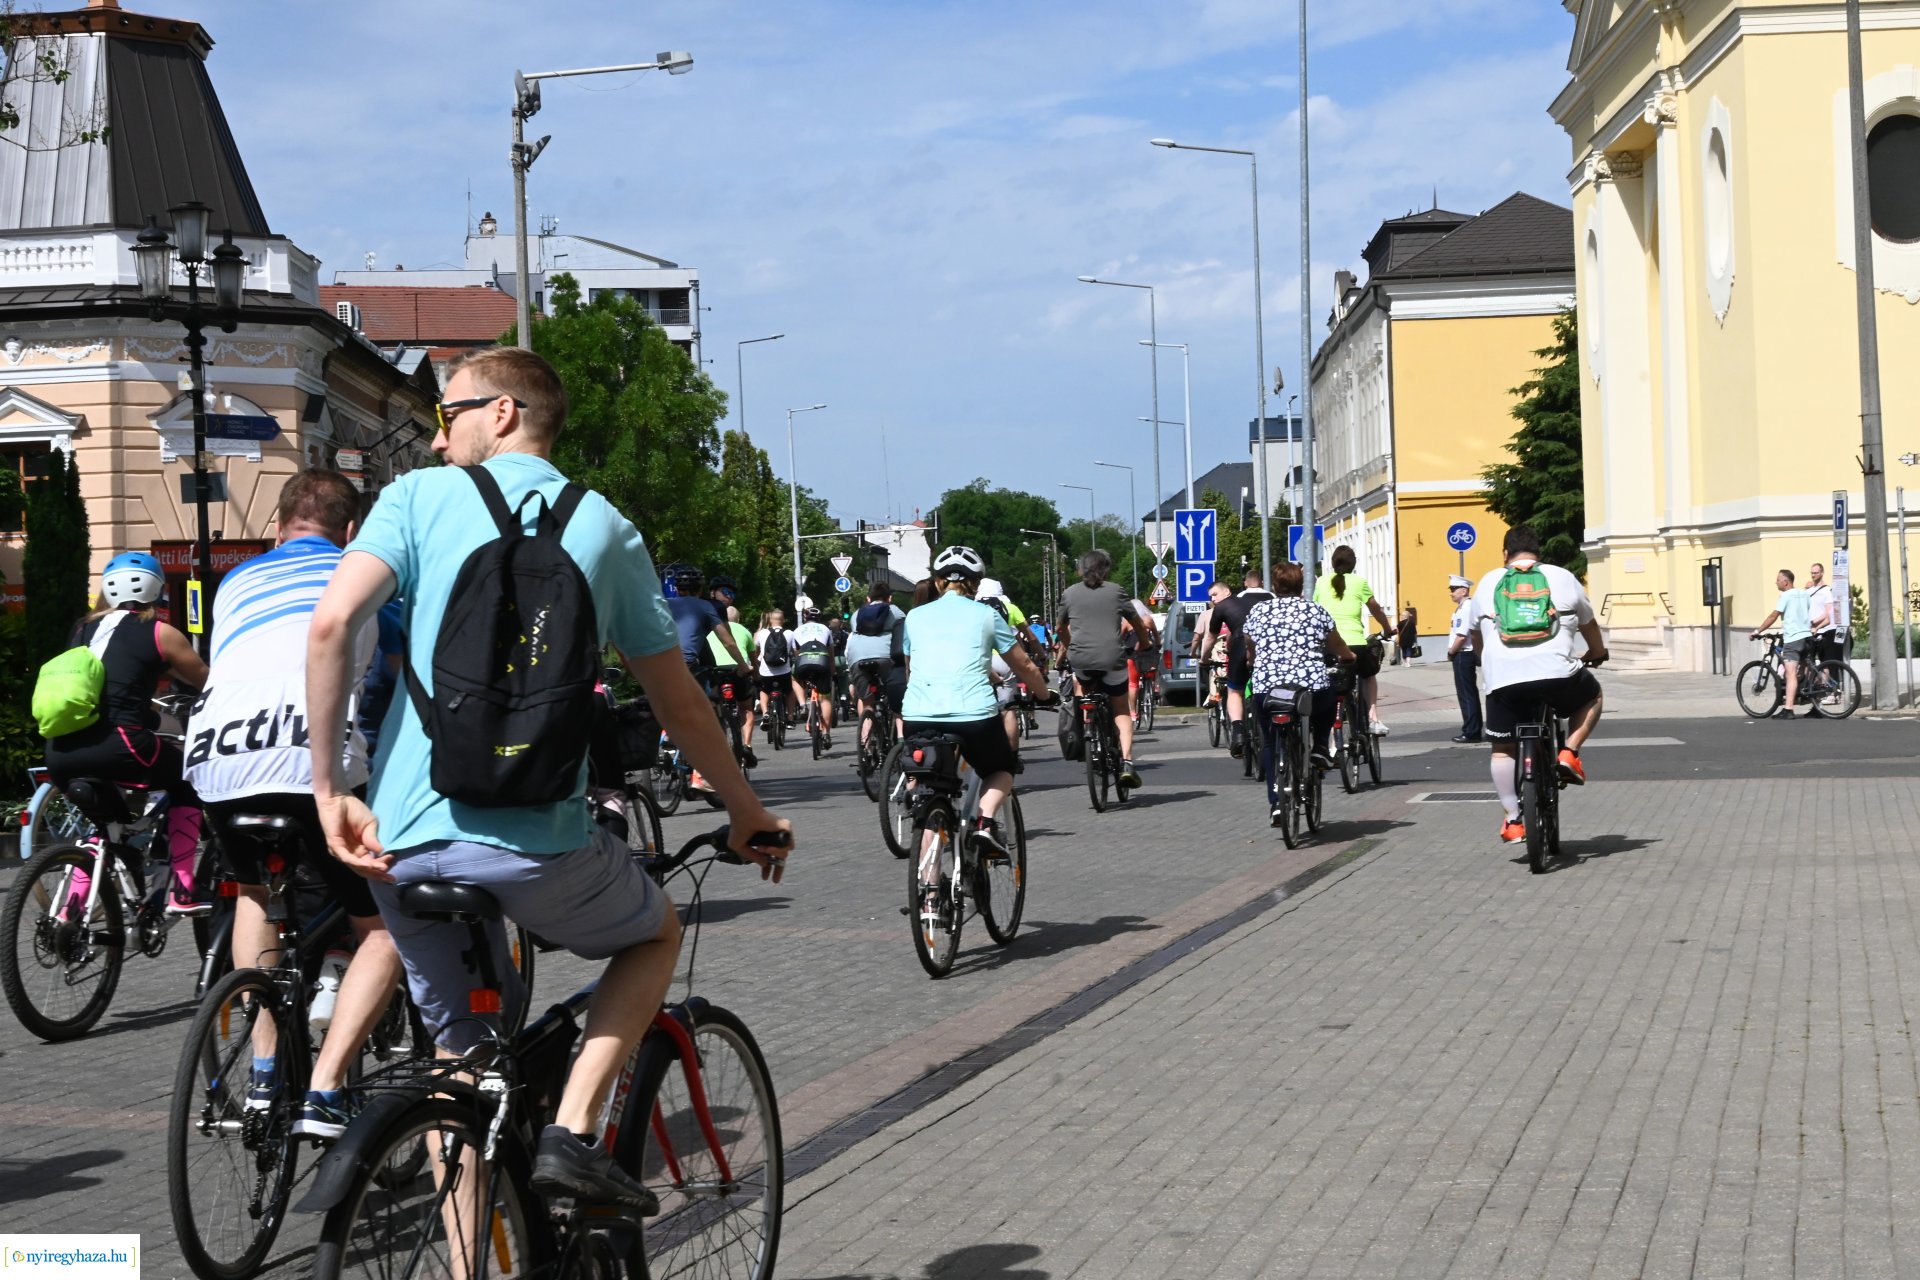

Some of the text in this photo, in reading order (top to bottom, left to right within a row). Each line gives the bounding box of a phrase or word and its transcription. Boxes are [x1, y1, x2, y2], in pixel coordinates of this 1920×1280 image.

[1836, 503, 1843, 527] P
[1185, 568, 1206, 598] P
[186, 704, 309, 768] activ
